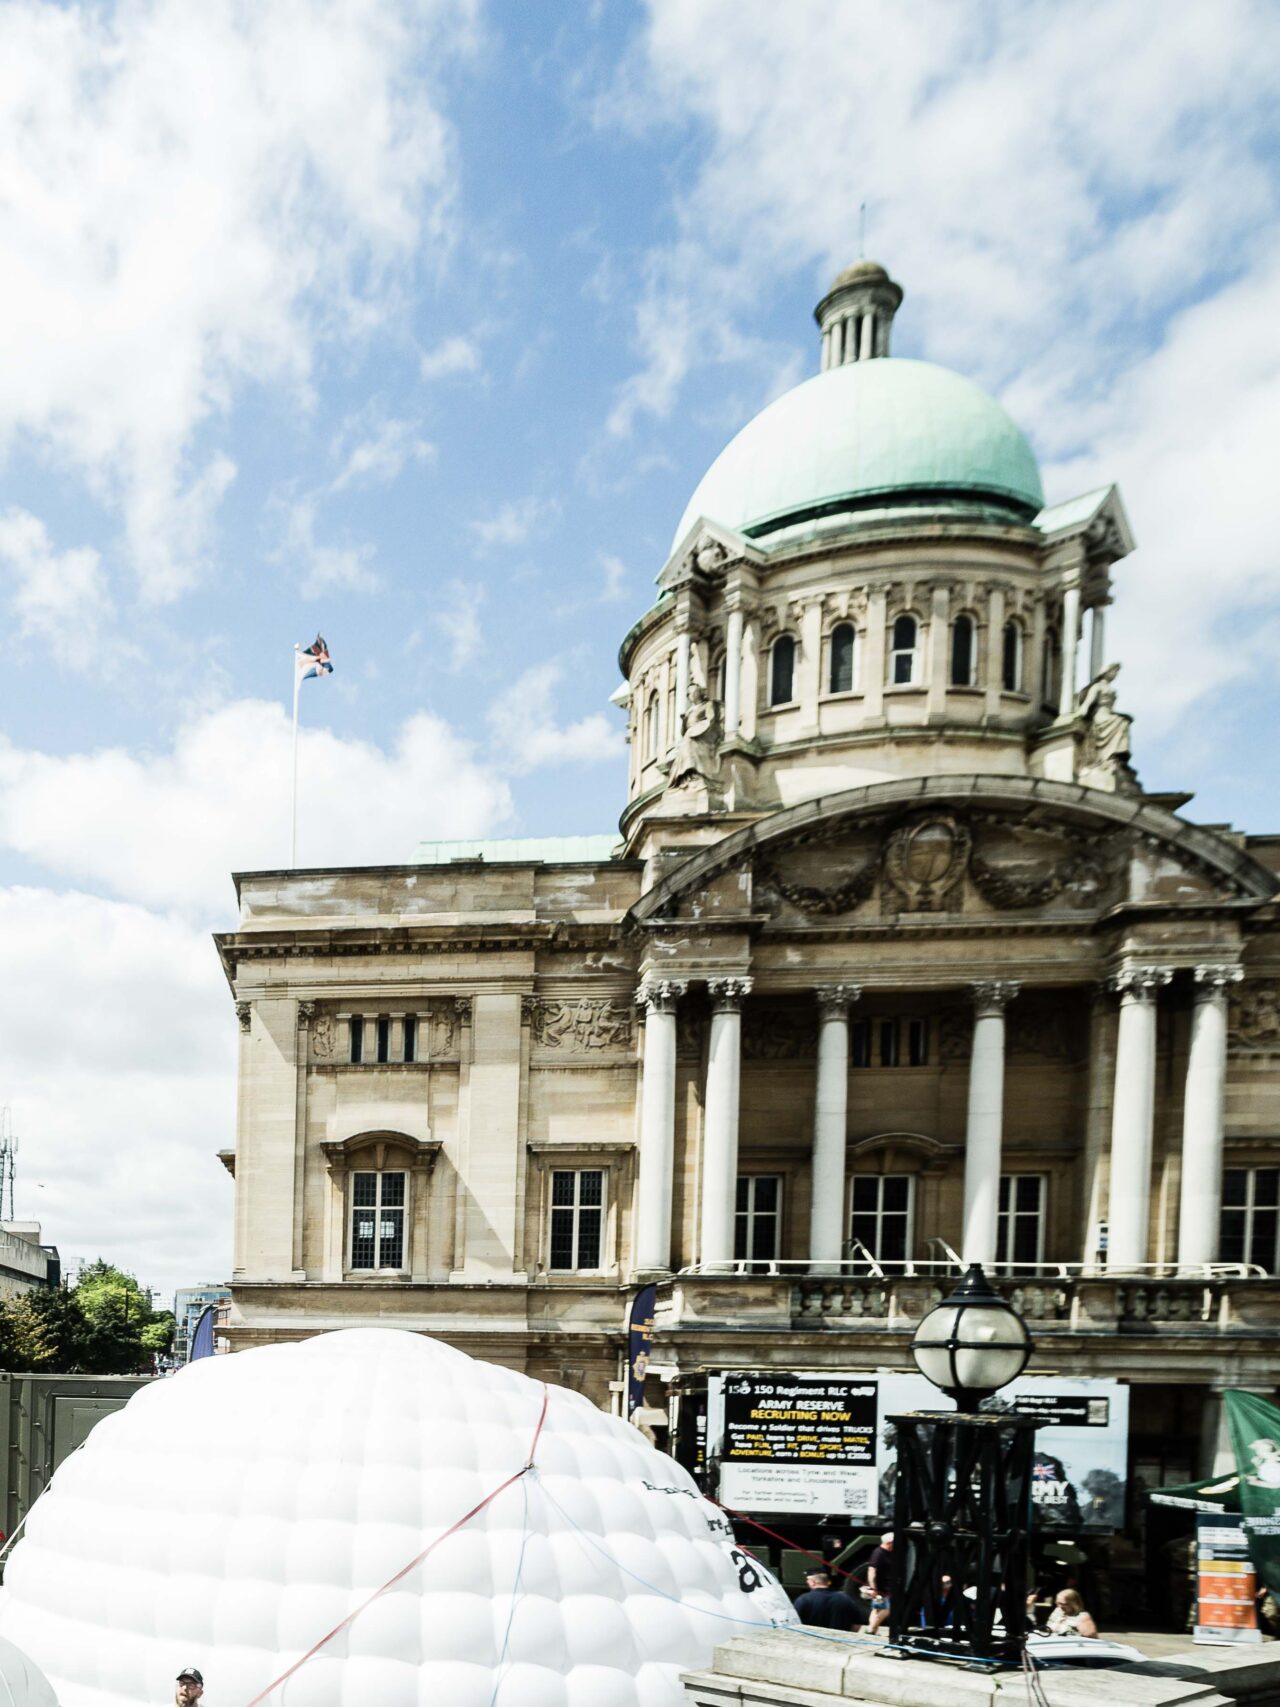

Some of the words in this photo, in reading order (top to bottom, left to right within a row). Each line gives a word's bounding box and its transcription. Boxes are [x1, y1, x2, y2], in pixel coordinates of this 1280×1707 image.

[754, 1385, 775, 1395] 150
[776, 1386, 826, 1397] Regiment
[827, 1387, 849, 1397] RLC
[757, 1400, 793, 1410] ARMY
[796, 1401, 845, 1411] RESERVE
[750, 1409, 818, 1421] RECRUITING
[821, 1412, 852, 1421] NOW
[728, 1423, 760, 1431] Become
[1031, 1480, 1070, 1496] RMY
